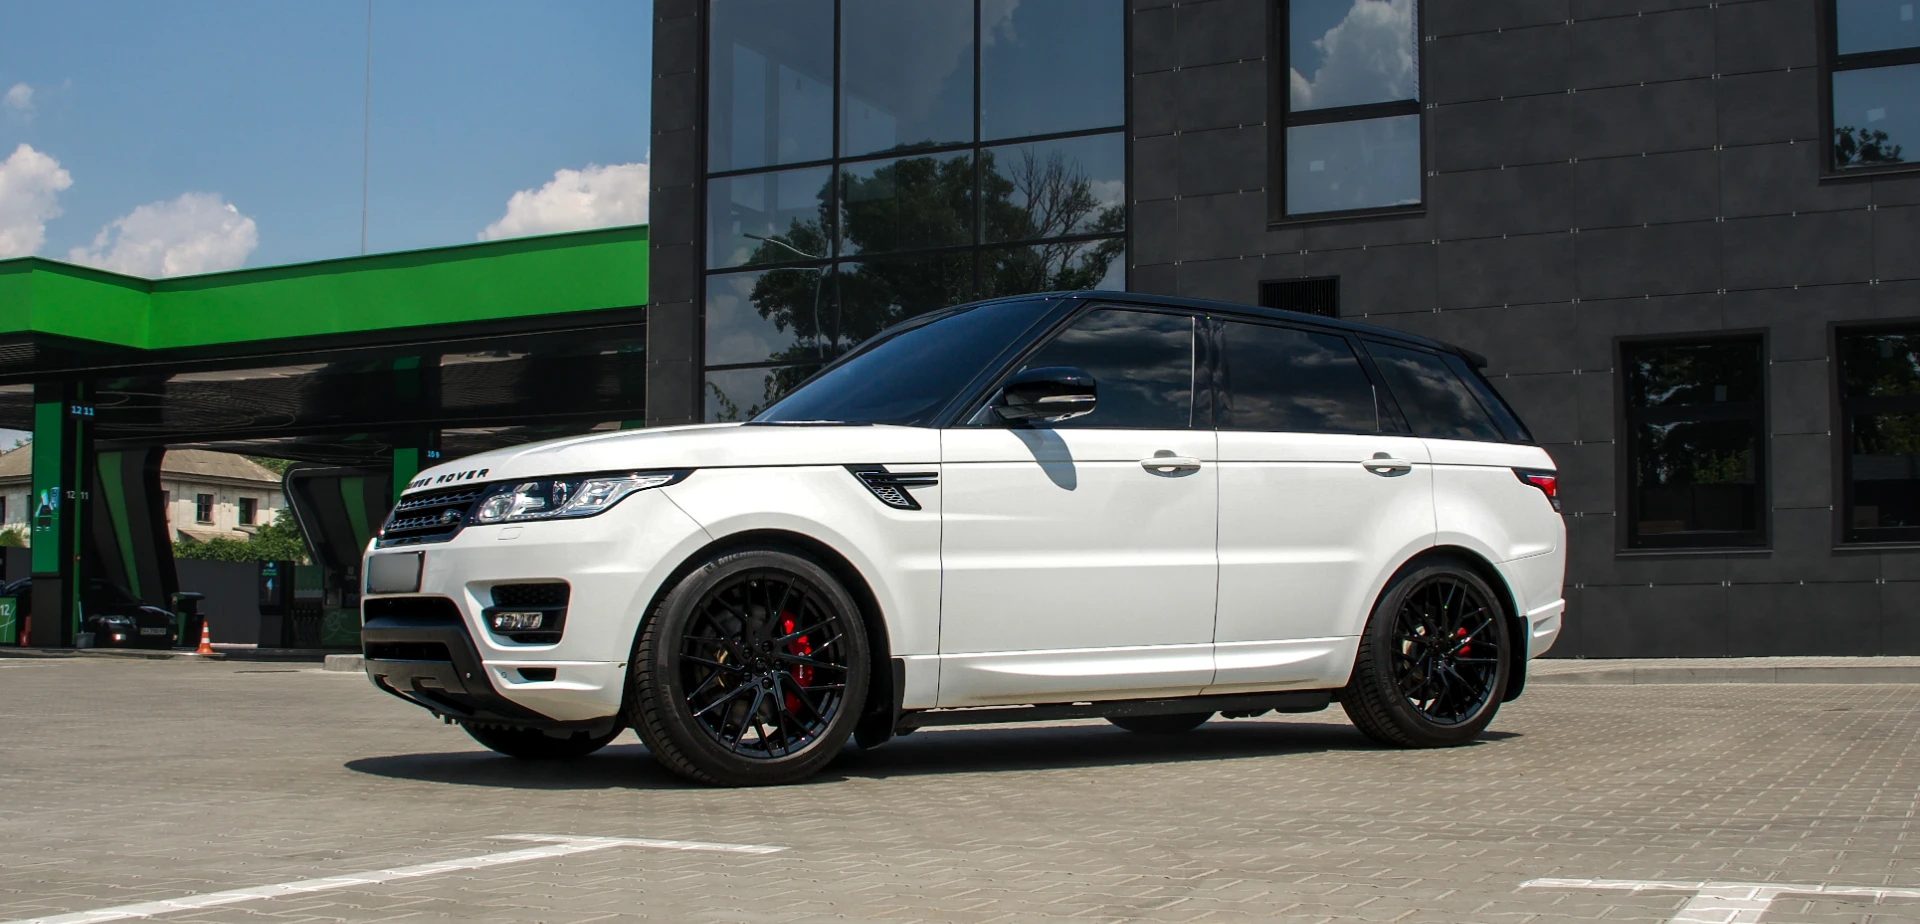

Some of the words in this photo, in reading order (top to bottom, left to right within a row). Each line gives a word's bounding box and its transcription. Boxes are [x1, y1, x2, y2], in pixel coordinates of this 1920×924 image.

[71, 405, 82, 415] 12
[83, 406, 95, 417] 11
[436, 468, 489, 484] ROVER
[65, 490, 76, 499] 12
[80, 491, 89, 500] 11
[0, 603, 10, 616] 12
